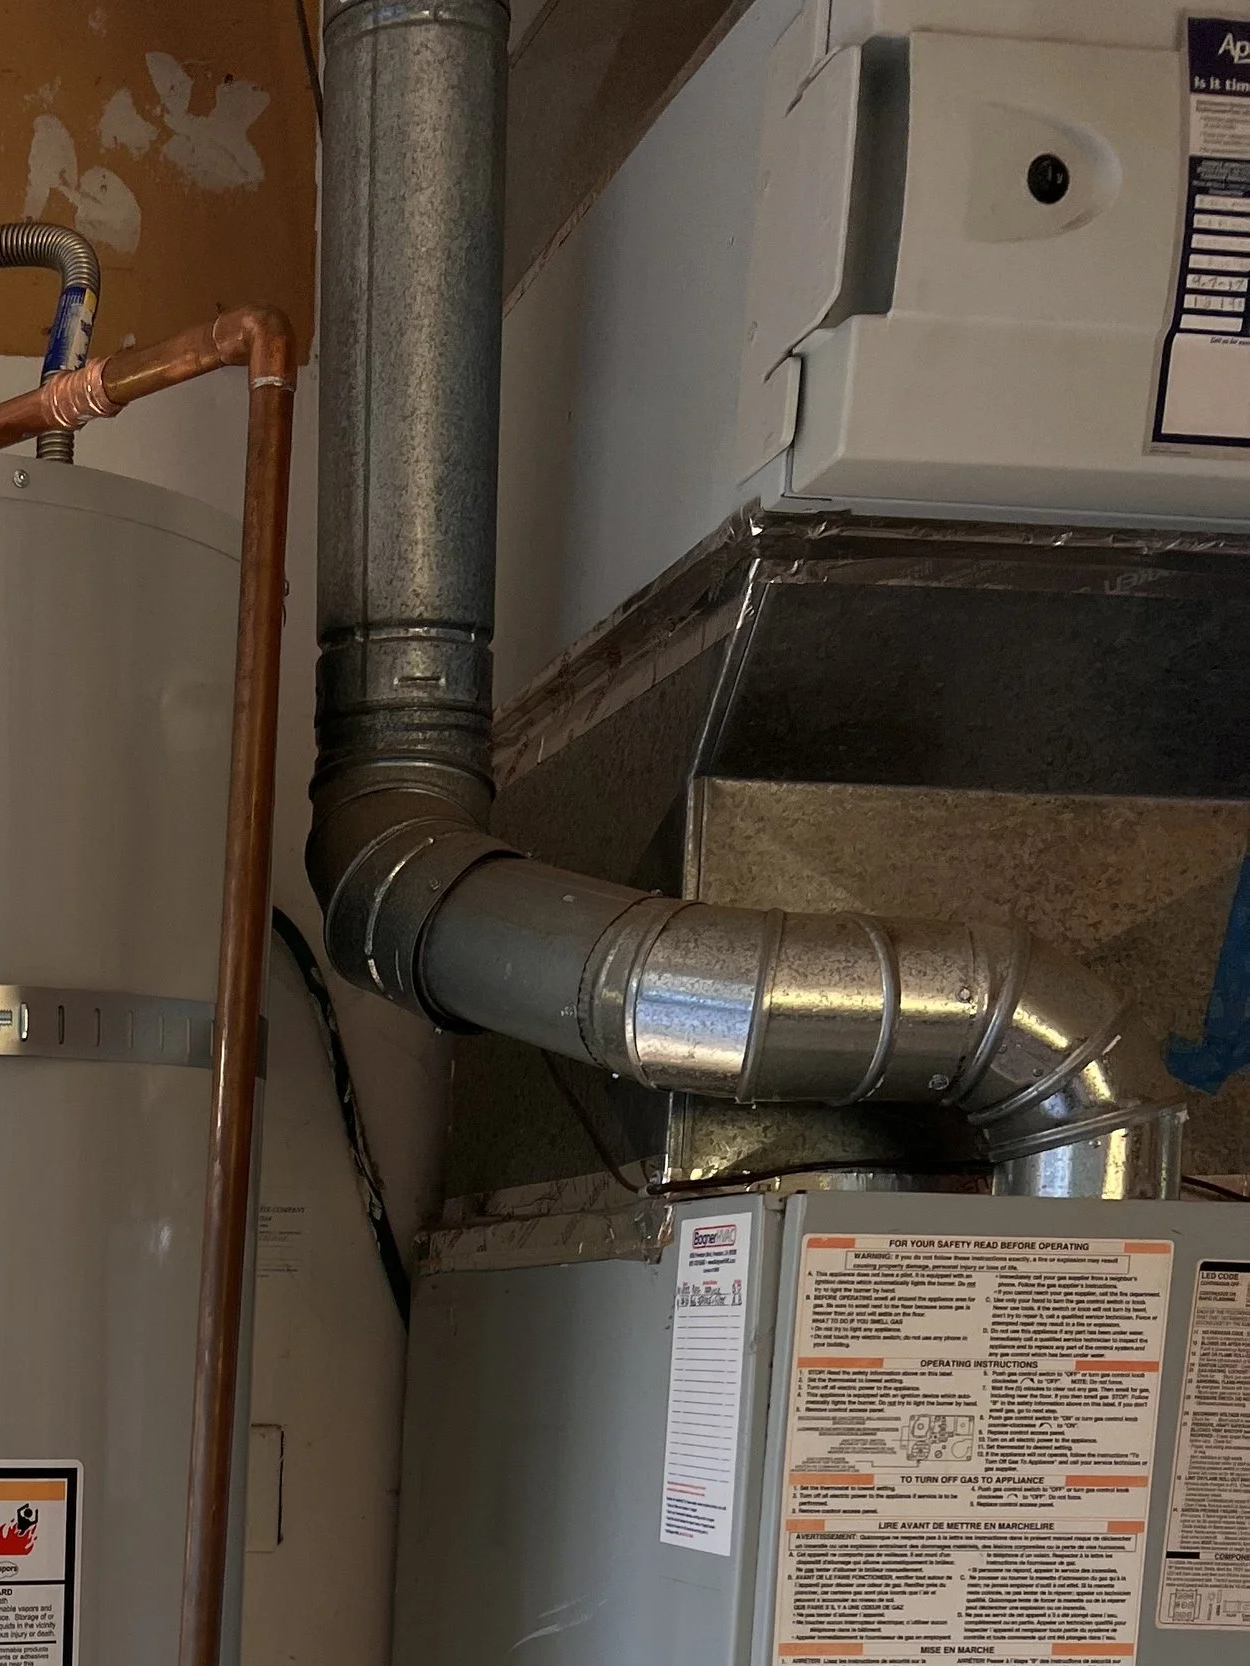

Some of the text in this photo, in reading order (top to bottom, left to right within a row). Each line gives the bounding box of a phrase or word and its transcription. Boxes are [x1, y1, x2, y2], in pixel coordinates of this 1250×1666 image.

[888, 1239, 1089, 1251] FOR YOUR SAFETY READ BEFORE OPERATING
[1201, 1271, 1239, 1280] LED CODE
[920, 1358, 1038, 1368] OPERATING INSTRUCTIONS
[900, 1475, 1044, 1484] TO TURN OFF GAS TO APPLIANCE
[877, 1521, 1054, 1530] LIRE AVANT DE METTRE EN MARCHELIRE
[40, 1604, 52, 1613] and
[14, 1612, 39, 1622] Storage
[39, 1612, 46, 1622] of
[47, 1614, 54, 1622] or
[943, 1646, 955, 1654] EN
